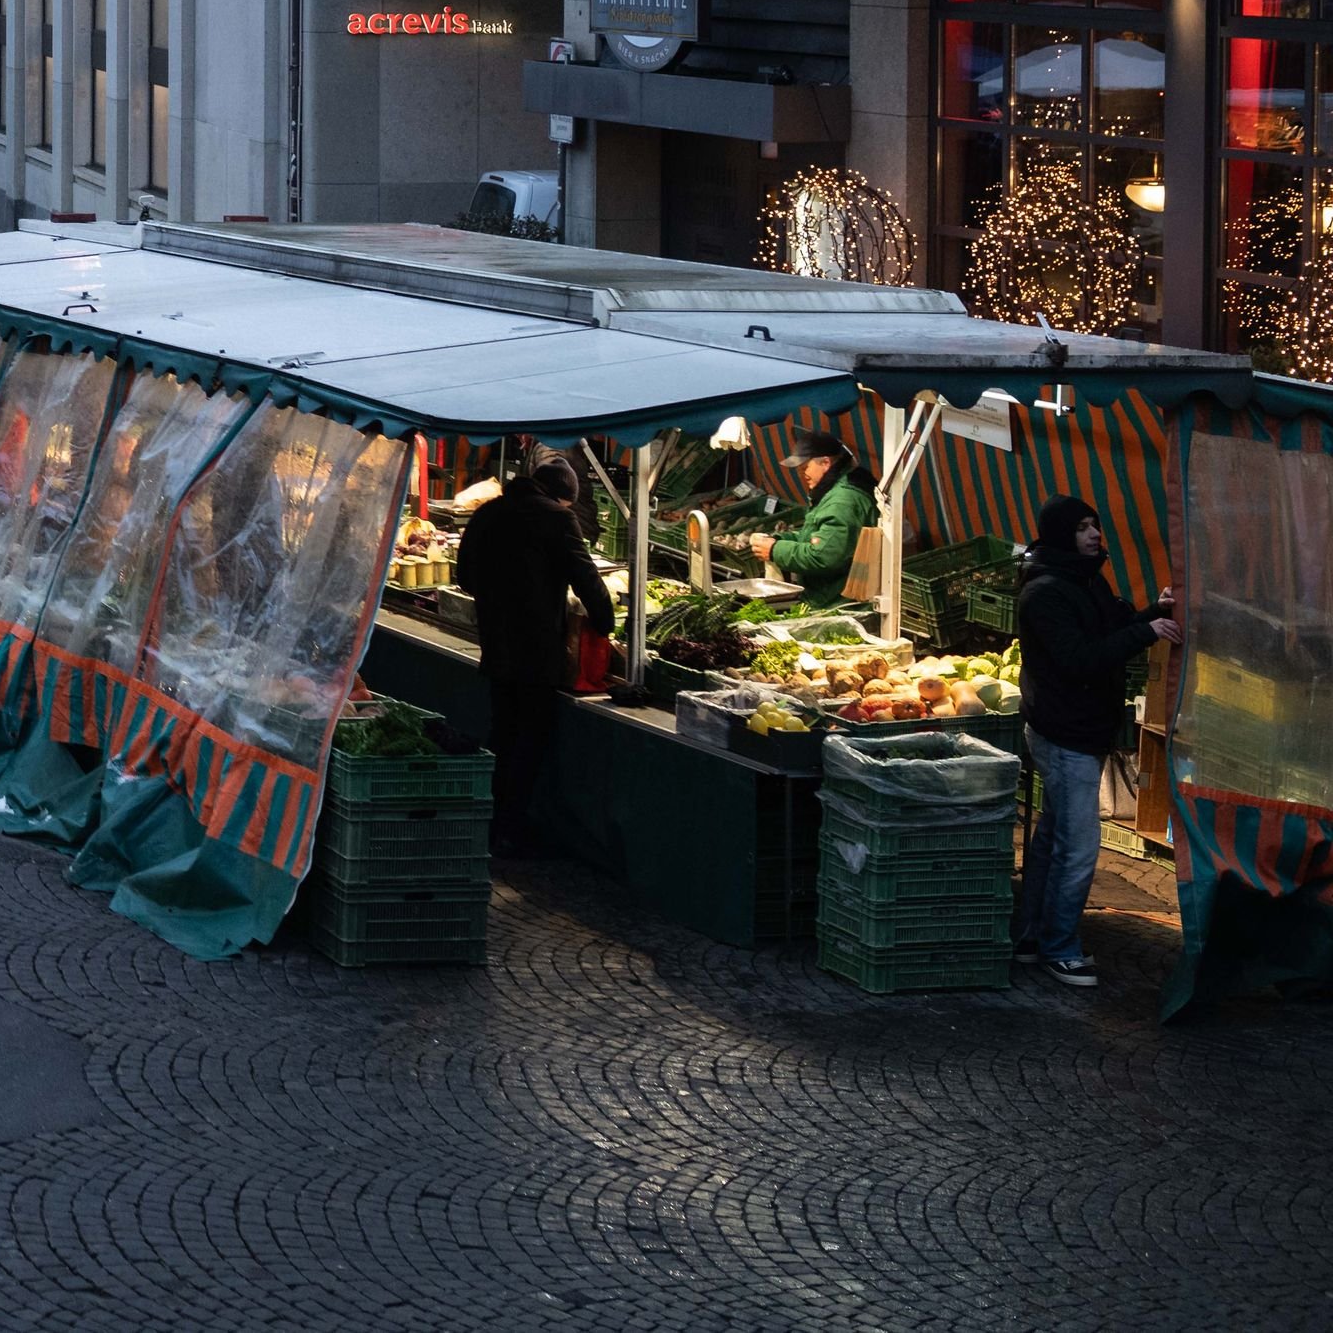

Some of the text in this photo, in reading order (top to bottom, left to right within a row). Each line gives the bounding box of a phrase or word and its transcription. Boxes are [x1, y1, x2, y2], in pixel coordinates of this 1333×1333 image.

[347, 5, 513, 35] acrevis Bank
[641, 45, 669, 65] SNACKS
